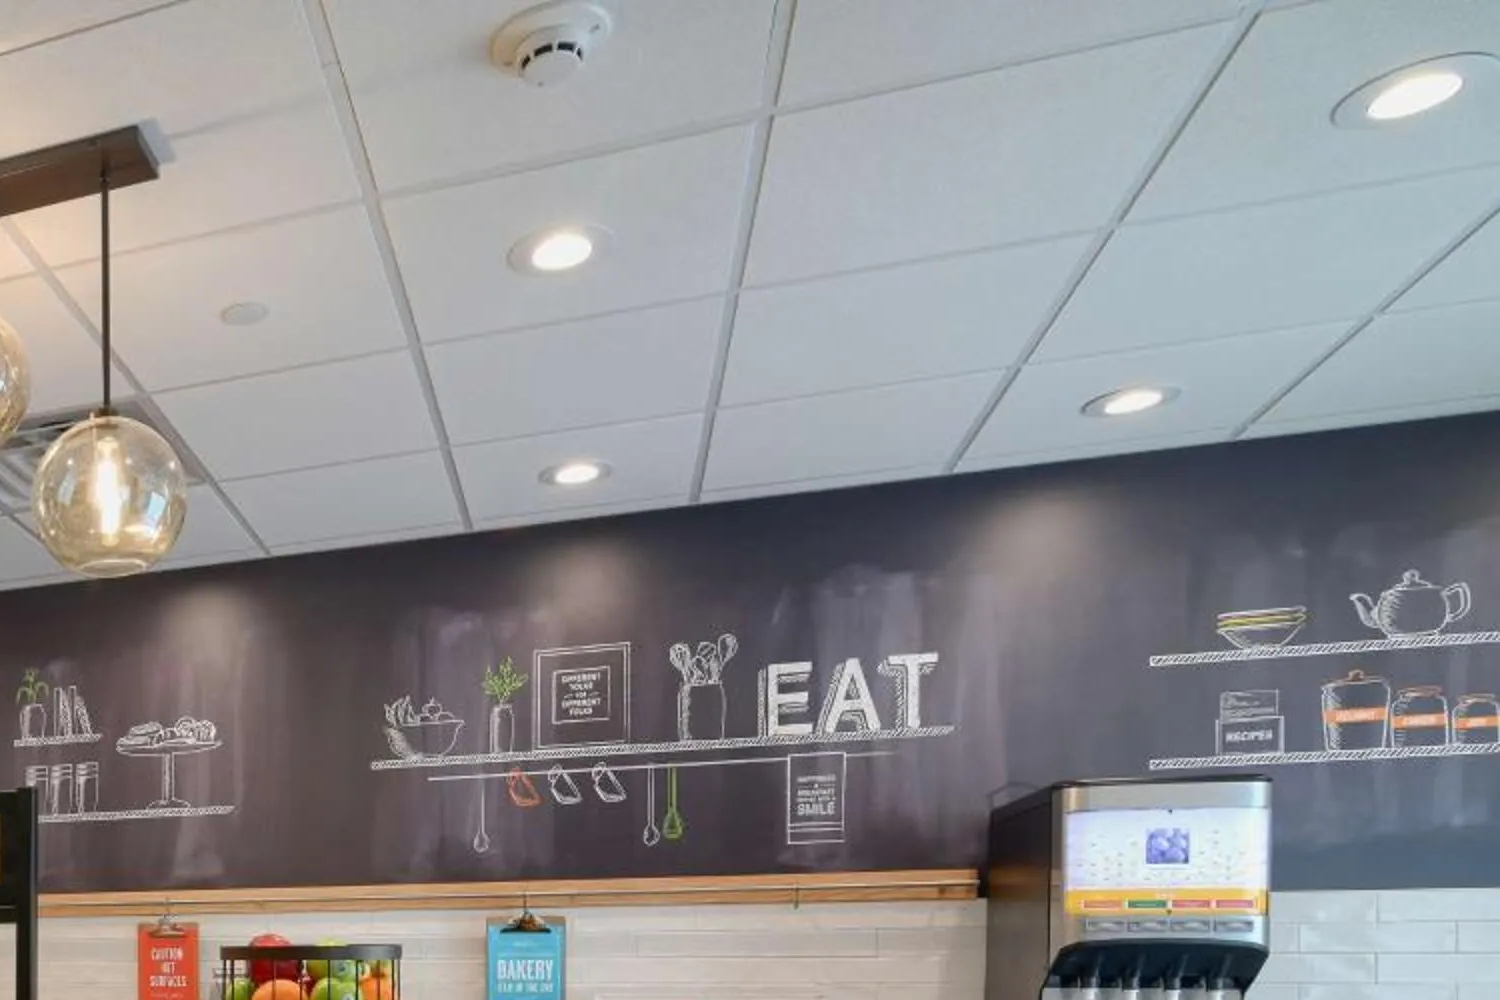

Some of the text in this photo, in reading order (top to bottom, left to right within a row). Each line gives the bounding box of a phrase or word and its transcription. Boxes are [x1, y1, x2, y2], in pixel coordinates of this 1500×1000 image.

[756, 651, 940, 738] EAT
[797, 801, 837, 816] SMILE
[497, 958, 553, 981] BAKERY
